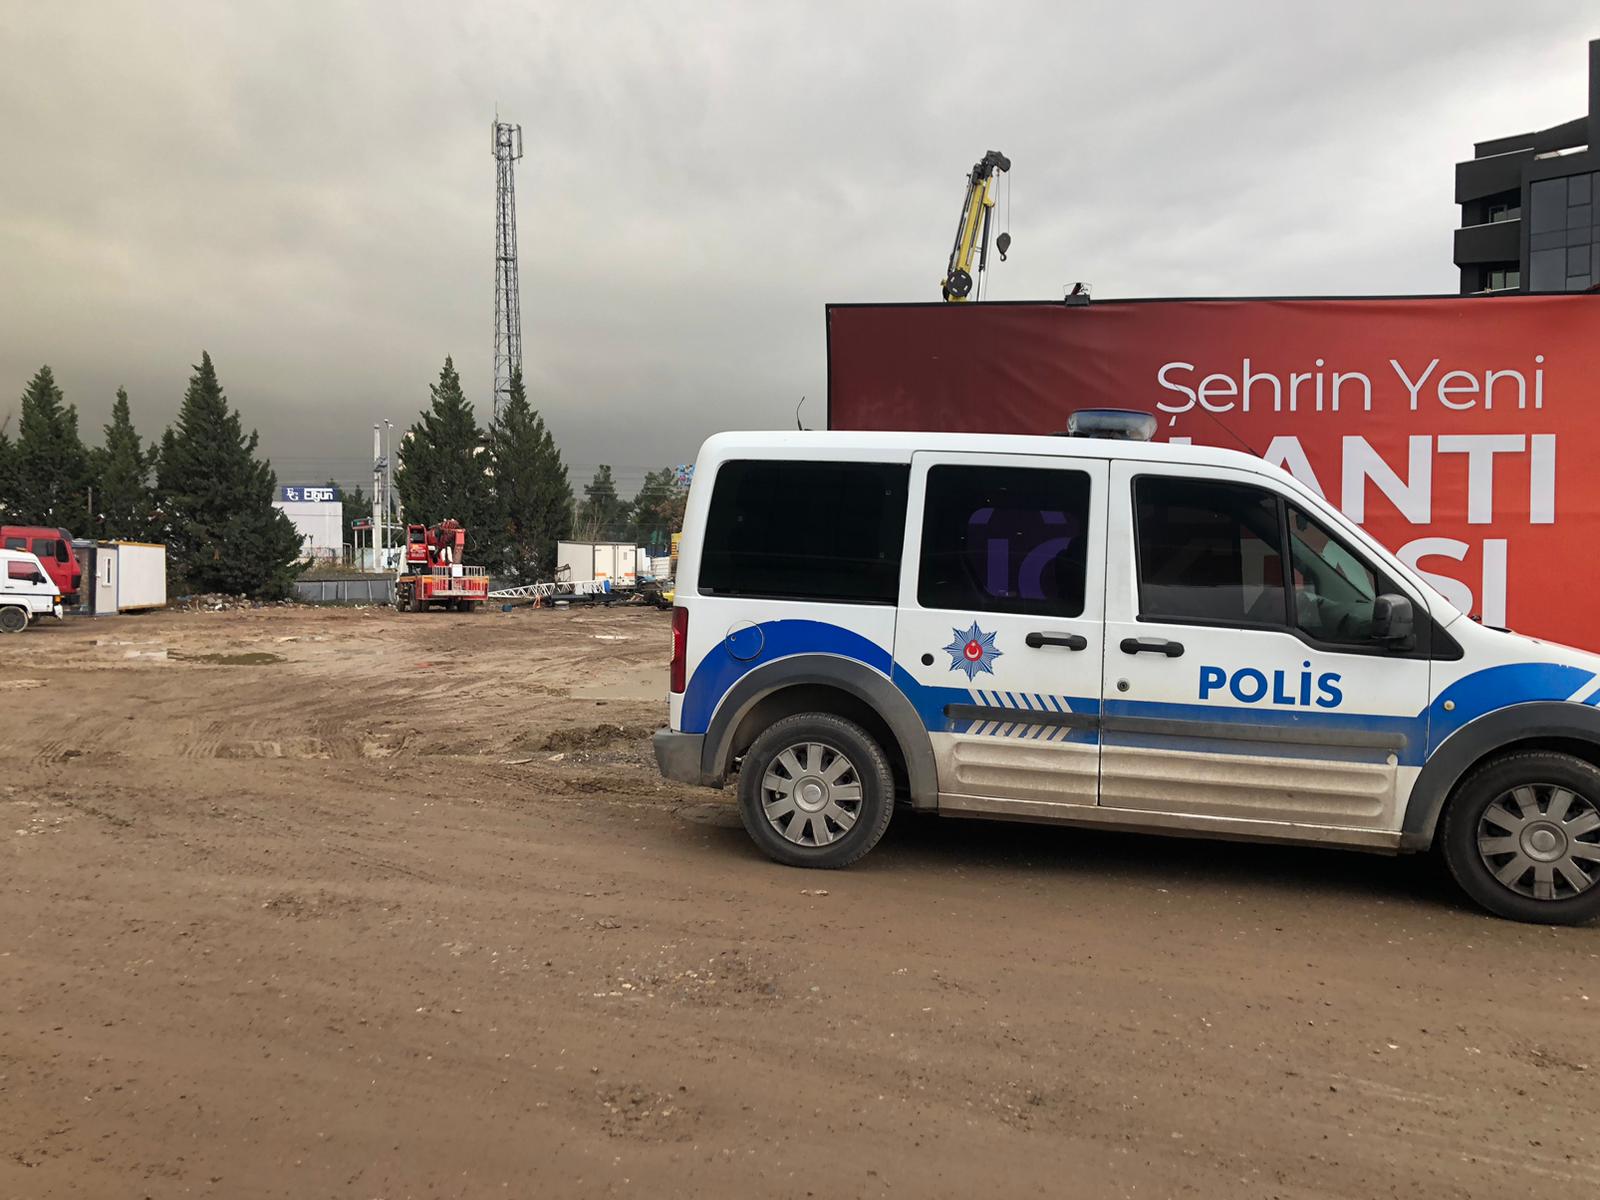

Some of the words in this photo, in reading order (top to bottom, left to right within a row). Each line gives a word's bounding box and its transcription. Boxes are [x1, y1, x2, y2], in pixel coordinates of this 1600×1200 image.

[1155, 357, 1372, 427] Şehrin
[1389, 354, 1544, 410] Yeni
[1198, 660, 1343, 709] POLİS
